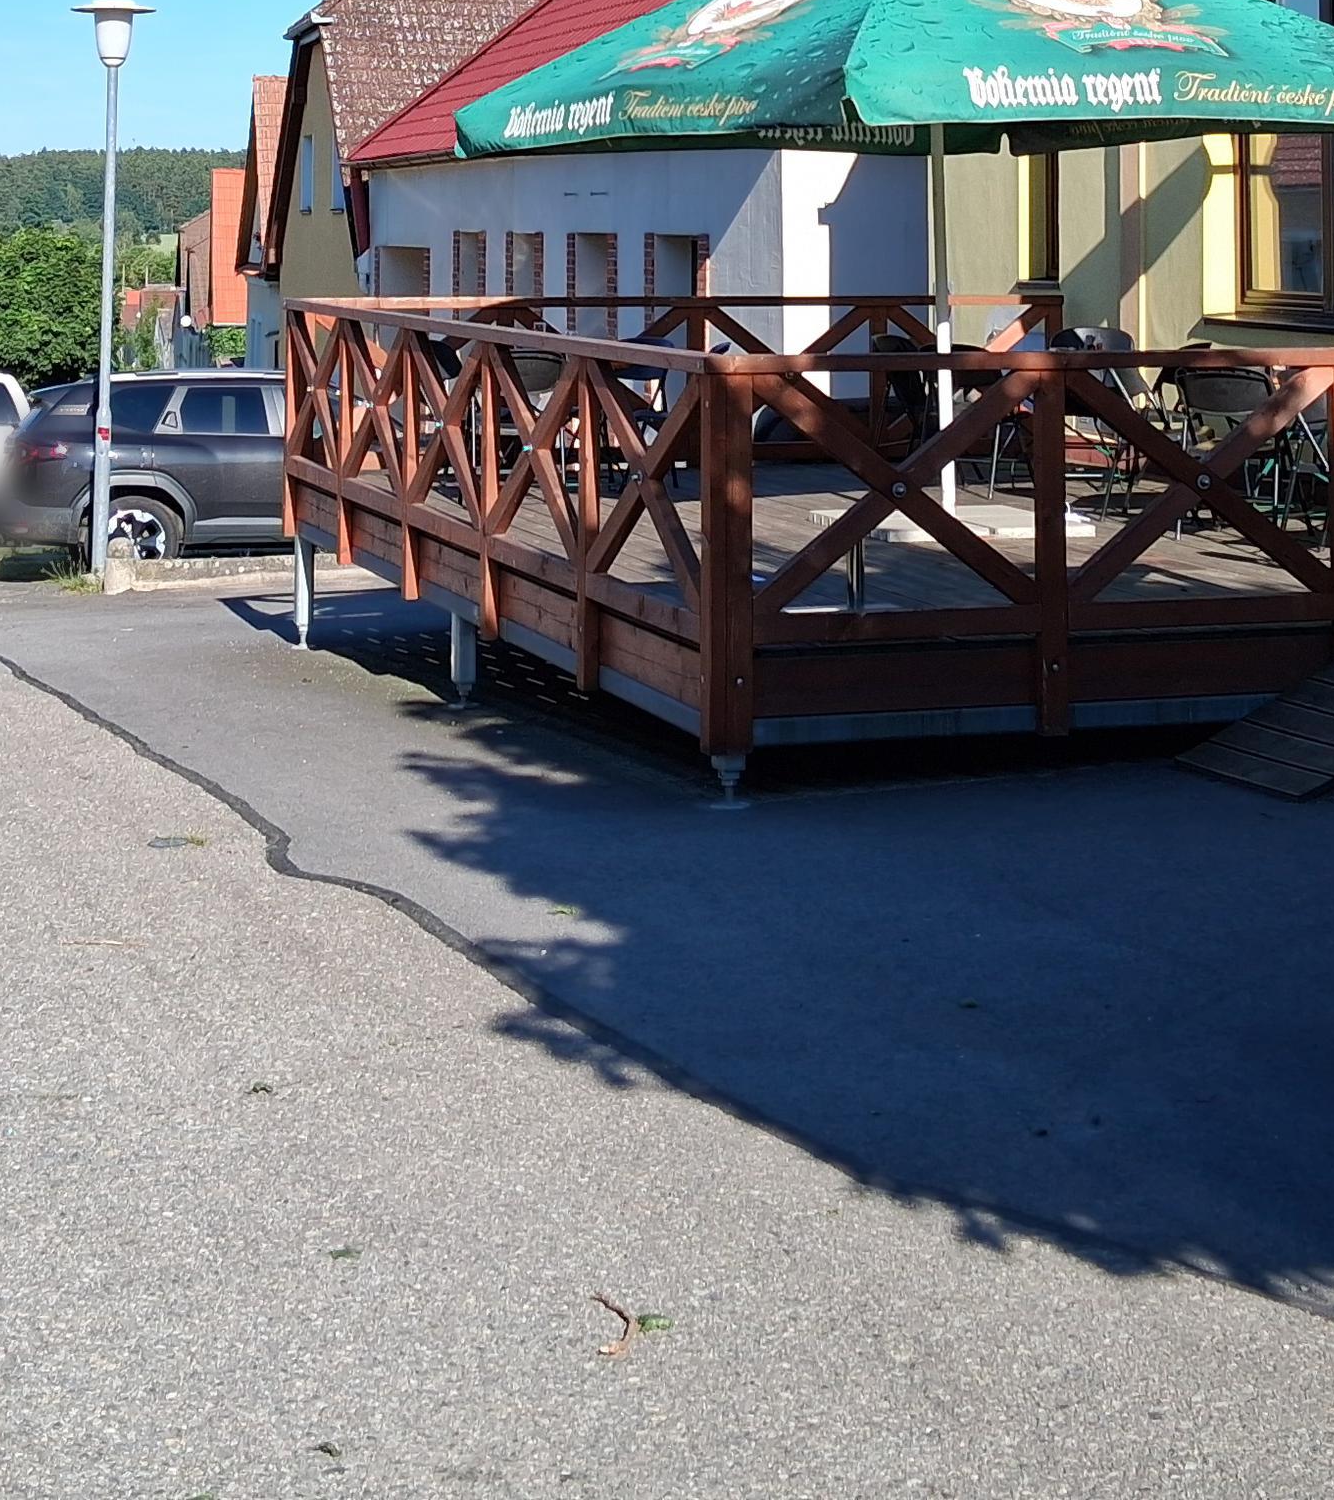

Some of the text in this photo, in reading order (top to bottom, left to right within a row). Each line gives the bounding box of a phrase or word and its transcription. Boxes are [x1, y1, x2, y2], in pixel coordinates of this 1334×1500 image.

[962, 65, 1079, 109] Bohemia
[1081, 67, 1163, 113] regent
[1173, 71, 1274, 104] Tradiční
[1275, 84, 1328, 107] české
[503, 99, 565, 139] Bohemia
[567, 90, 616, 136] regent
